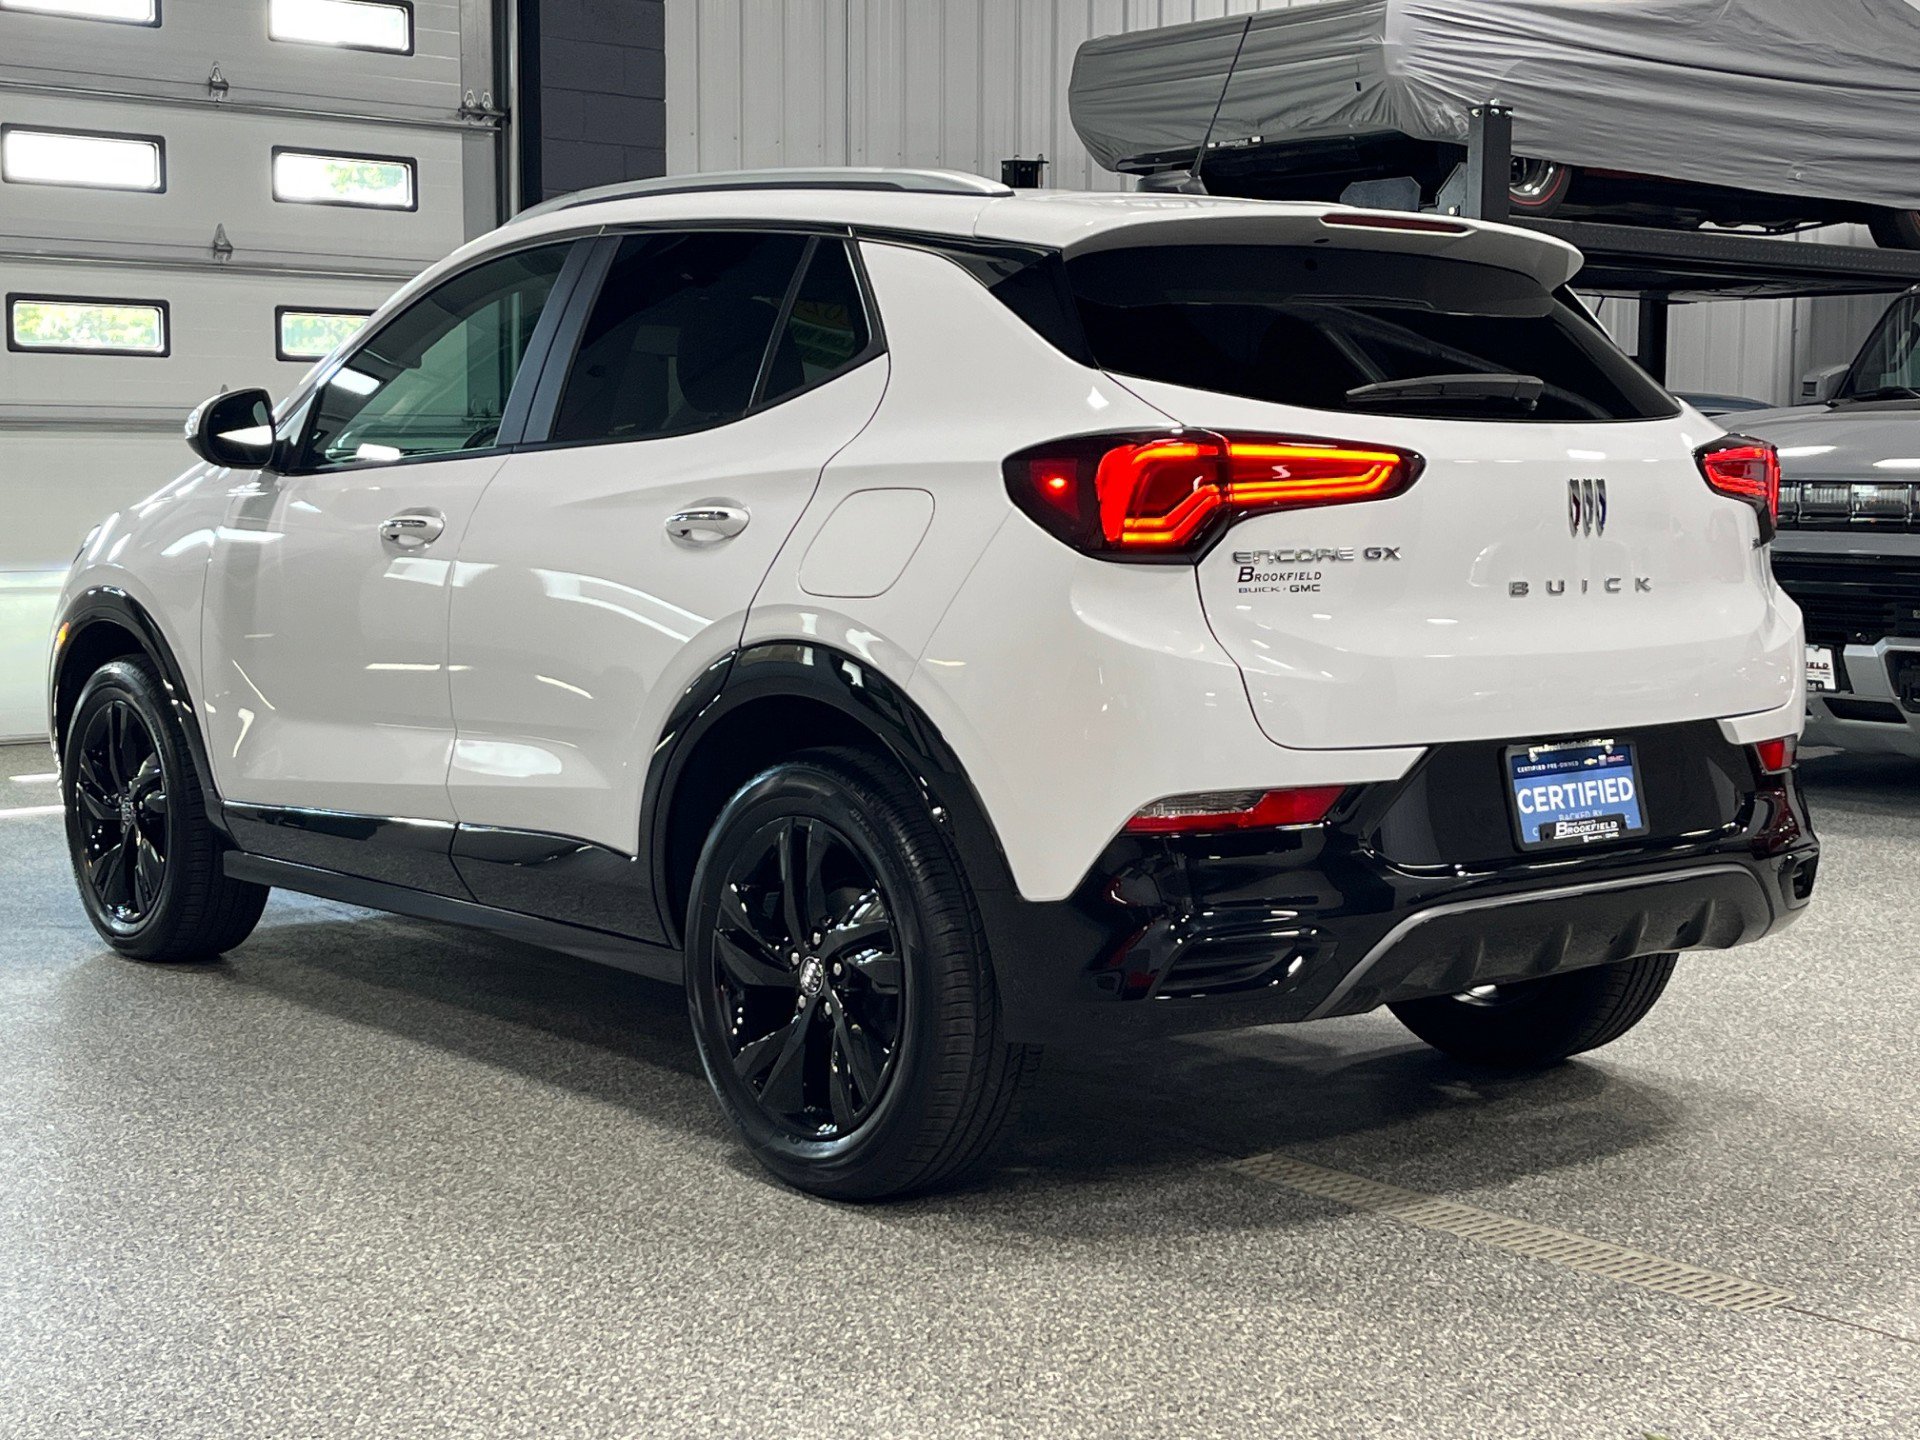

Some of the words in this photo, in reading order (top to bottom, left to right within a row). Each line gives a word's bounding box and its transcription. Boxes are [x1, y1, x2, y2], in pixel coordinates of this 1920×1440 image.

[1232, 547, 1355, 564] ENCORE
[1364, 547, 1402, 560] GX
[1237, 566, 1322, 583] BROOKFIELD
[1238, 585, 1281, 594] BUICK
[1289, 584, 1321, 593] GMC
[1508, 577, 1652, 597] BUICK
[1517, 777, 1634, 814] CERTIFIED
